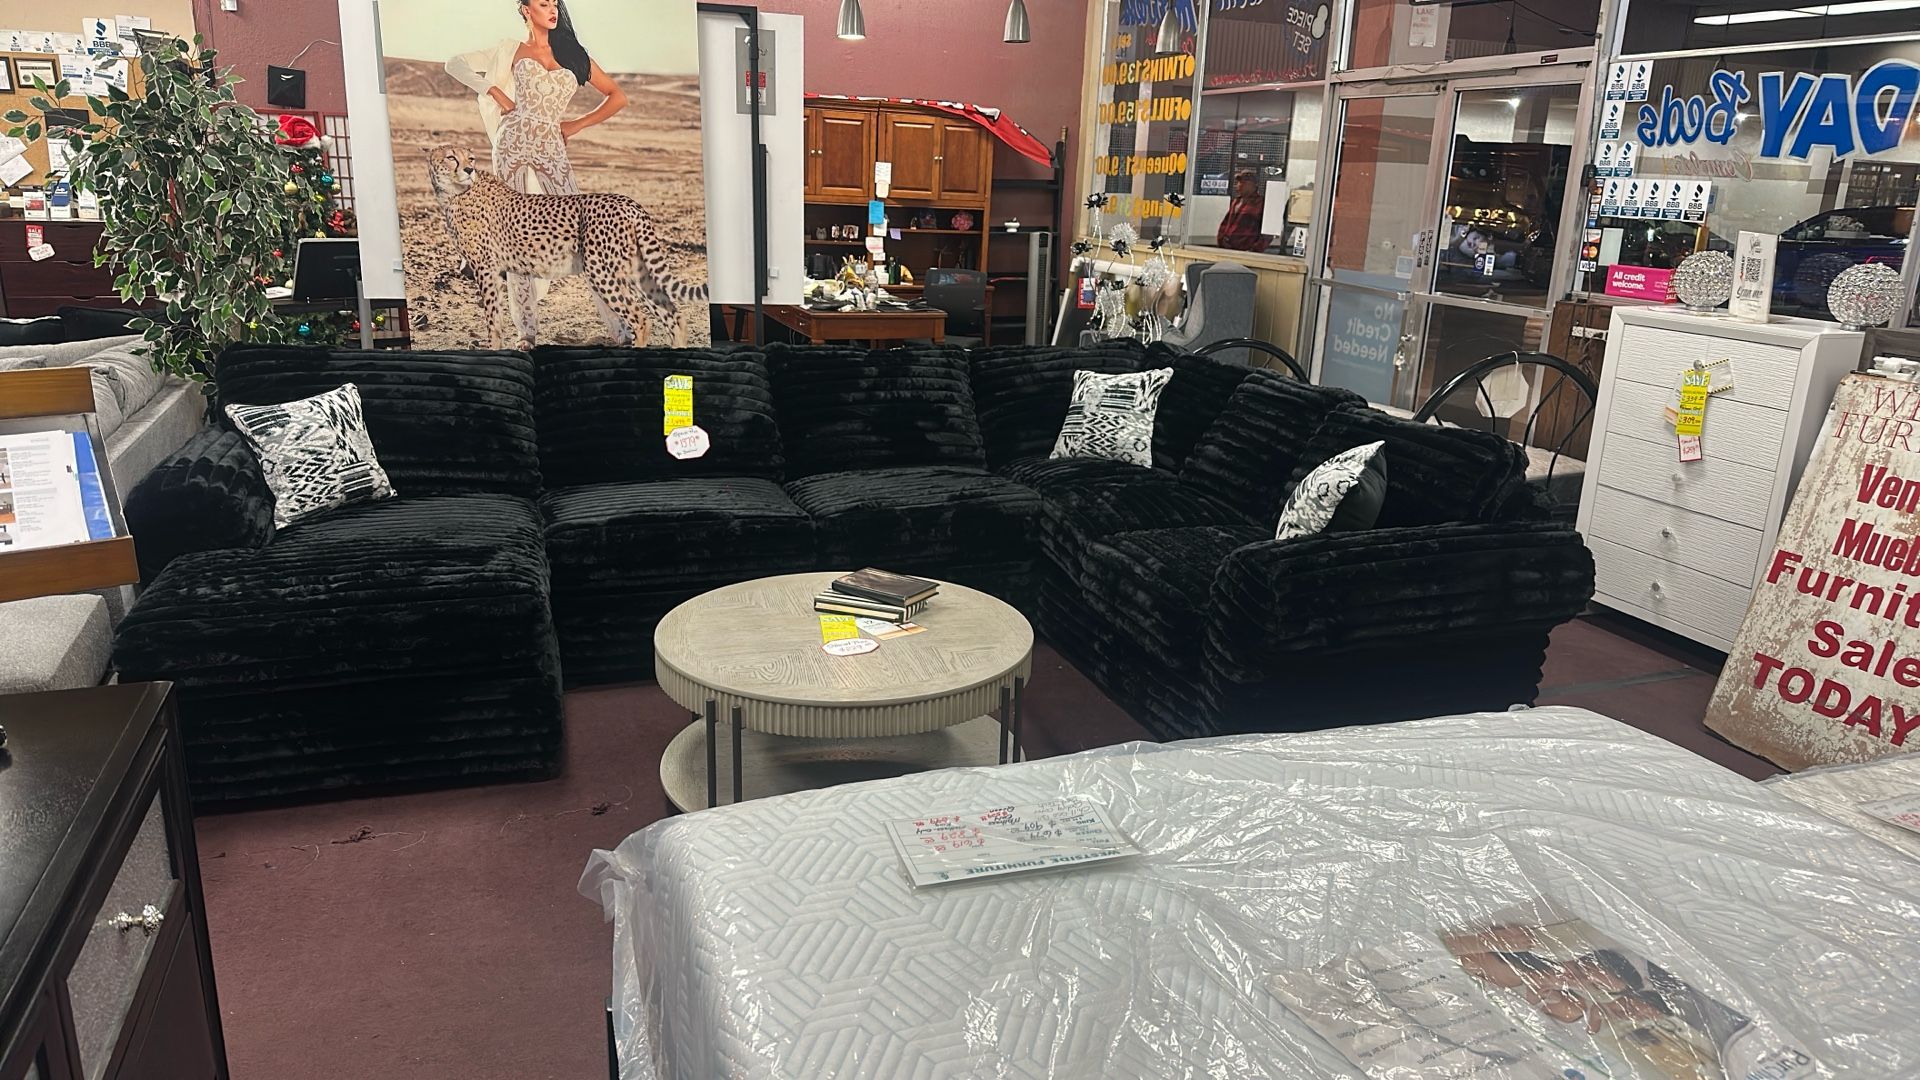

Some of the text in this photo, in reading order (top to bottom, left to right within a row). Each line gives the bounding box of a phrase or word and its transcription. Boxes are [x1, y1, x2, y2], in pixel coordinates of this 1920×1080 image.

[1612, 280, 1646, 290] welcome.
[1613, 271, 1646, 282] All credit
[1684, 374, 1709, 387] SAVE
[1807, 620, 1920, 689] Sale
[1753, 652, 1920, 748] TODAY
[966, 850, 1121, 874] WESTSIDE FURNITURE
